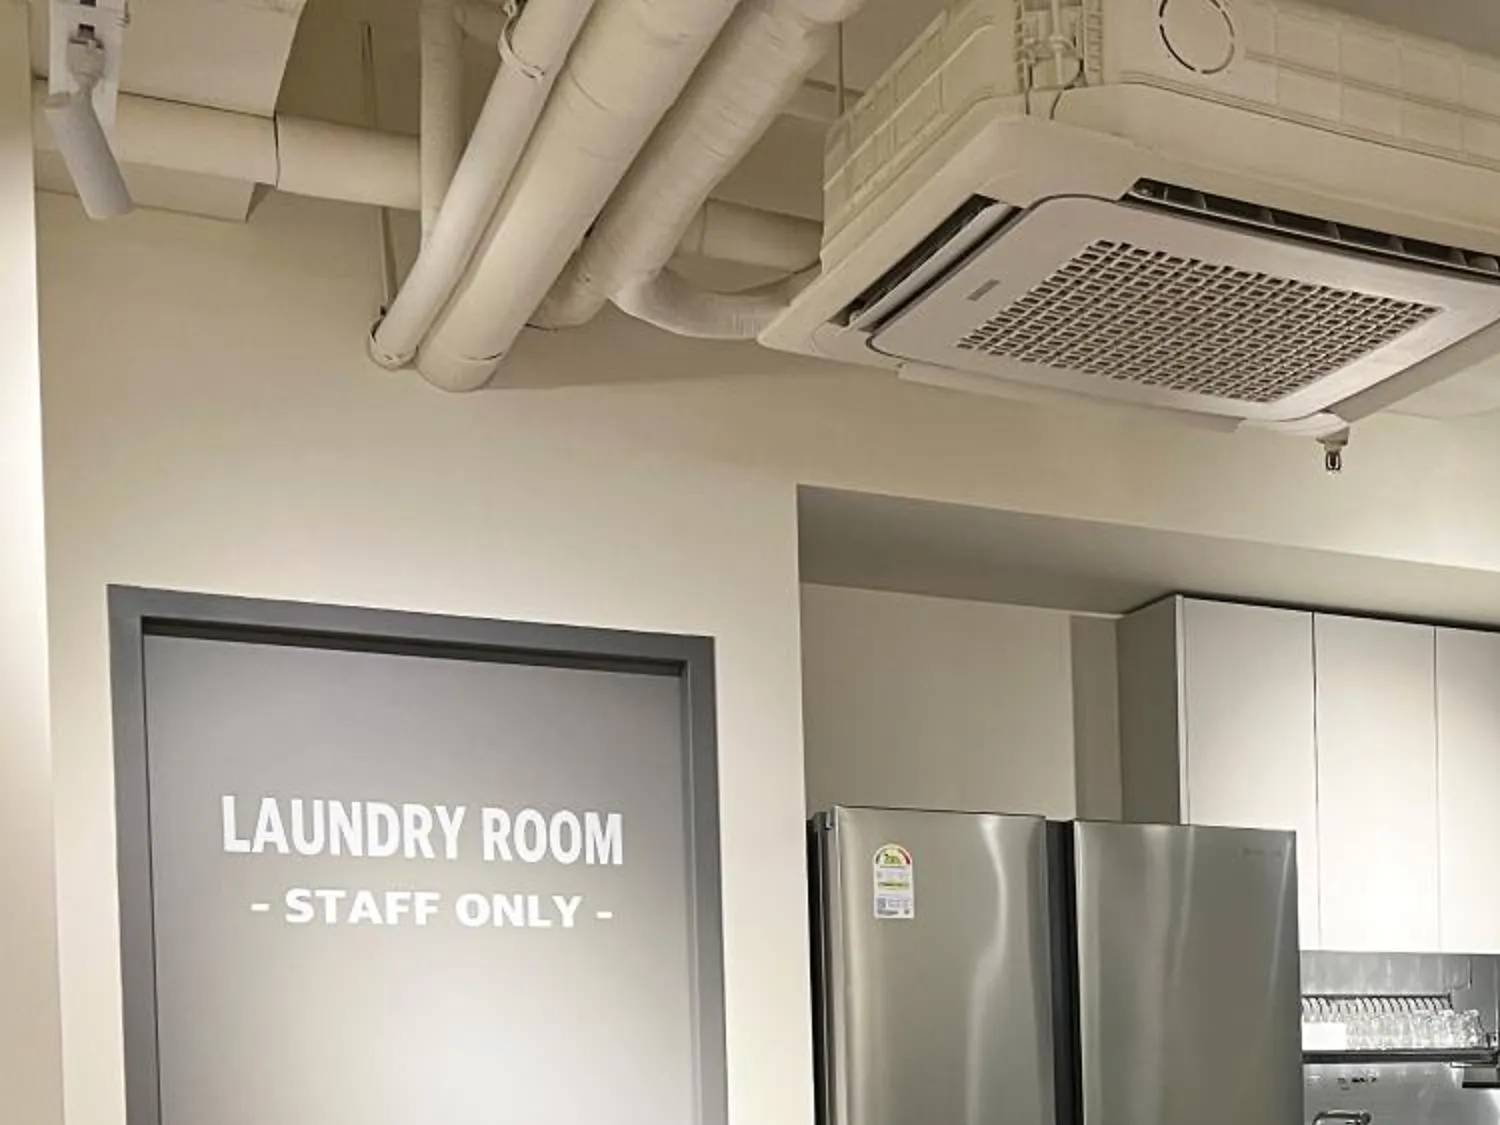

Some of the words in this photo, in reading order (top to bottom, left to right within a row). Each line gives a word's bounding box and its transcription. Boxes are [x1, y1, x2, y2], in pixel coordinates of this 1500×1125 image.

[221, 795, 467, 859] LAUNDRY
[481, 807, 623, 865] ROOM
[285, 887, 441, 925] STAFF
[455, 893, 583, 928] ONLY
